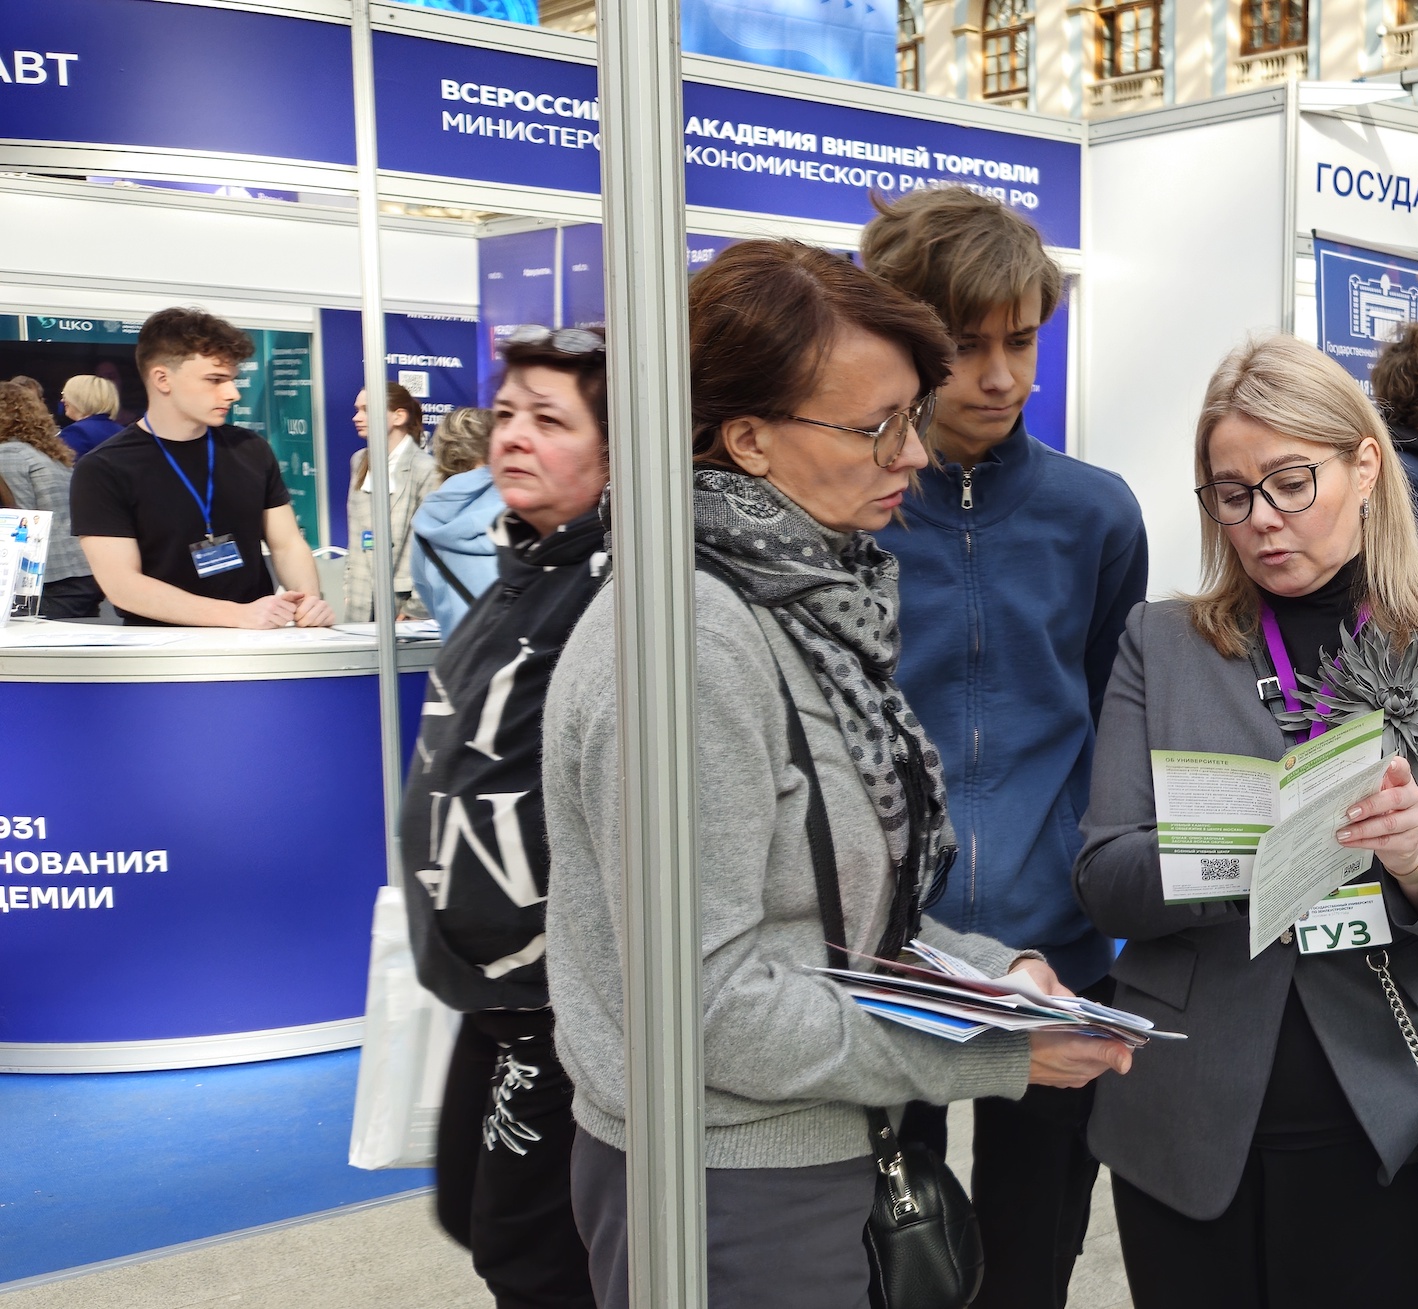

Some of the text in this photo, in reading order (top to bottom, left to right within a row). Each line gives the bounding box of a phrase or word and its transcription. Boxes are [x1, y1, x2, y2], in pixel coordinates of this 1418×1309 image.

[685, 116, 817, 153] АКАДЕМИЯ
[822, 135, 930, 170] ВНЕШНЕЙ
[933, 152, 1040, 185] ТОРГОВЛИ
[685, 144, 895, 191] КОНОМИЧЕСКОГО
[1010, 190, 1040, 210] РФ
[59, 320, 93, 331] ЦКО
[384, 353, 463, 368] НГВИСТИКА
[1299, 920, 1371, 951] ГУЗ
